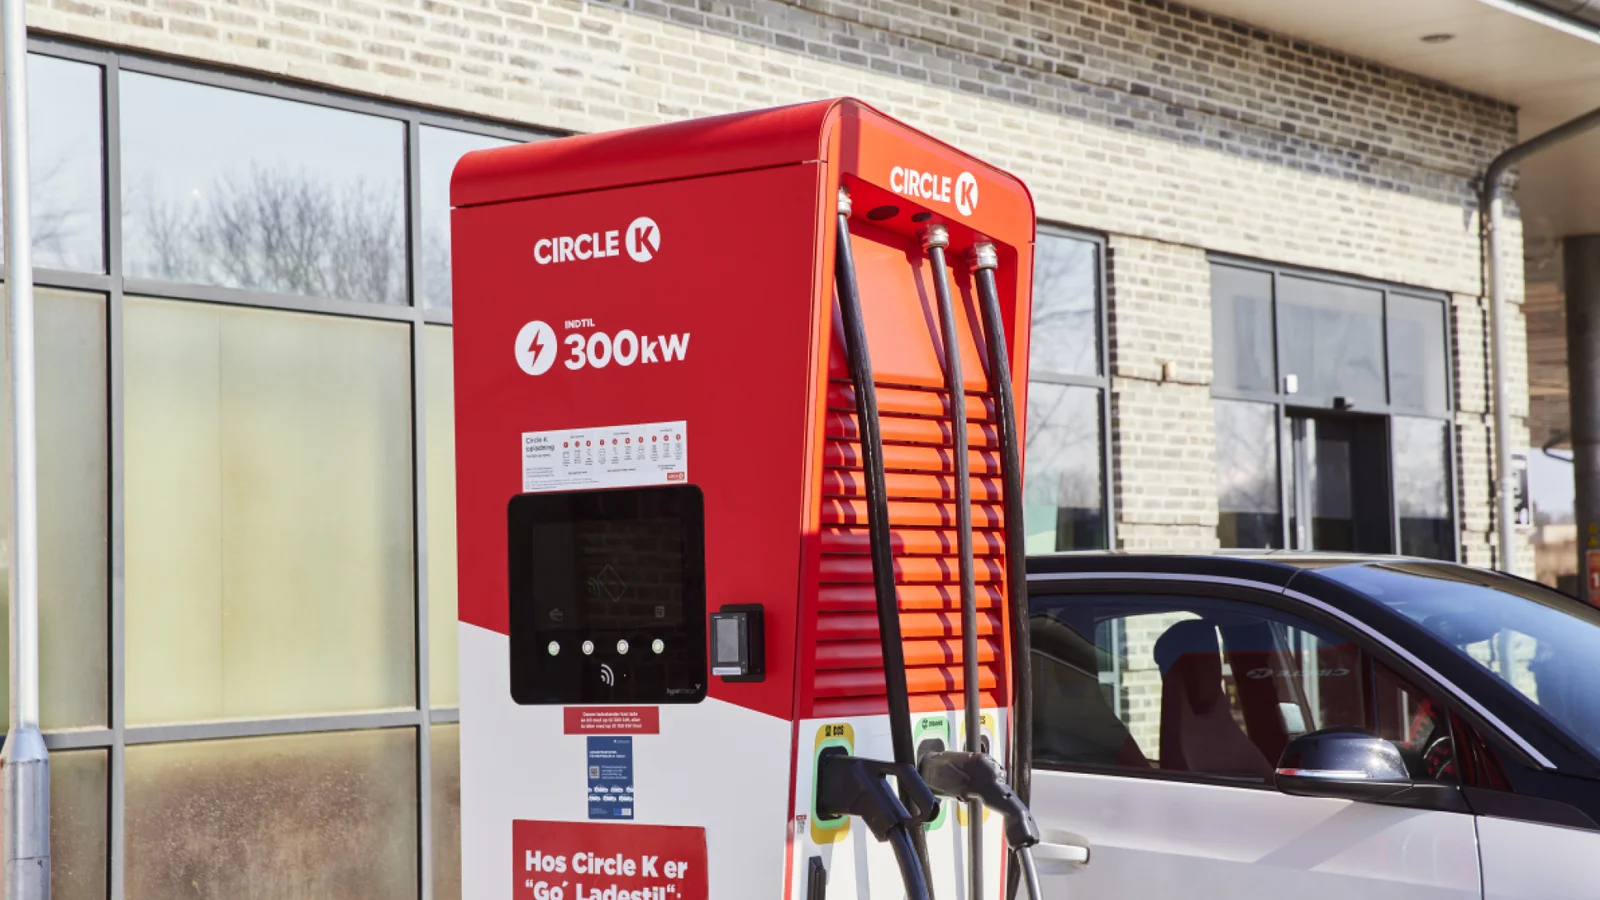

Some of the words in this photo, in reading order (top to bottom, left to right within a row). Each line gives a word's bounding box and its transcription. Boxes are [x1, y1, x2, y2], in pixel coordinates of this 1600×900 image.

[890, 166, 952, 203] CIRCLE
[957, 176, 977, 215] K
[534, 230, 619, 265] CIRCLE
[629, 220, 660, 262] K
[564, 318, 595, 329] INDTIL
[564, 329, 691, 371] 300kW
[525, 849, 567, 874] Hos
[572, 851, 637, 876] Circle
[641, 855, 659, 878] K
[663, 860, 688, 879] er
